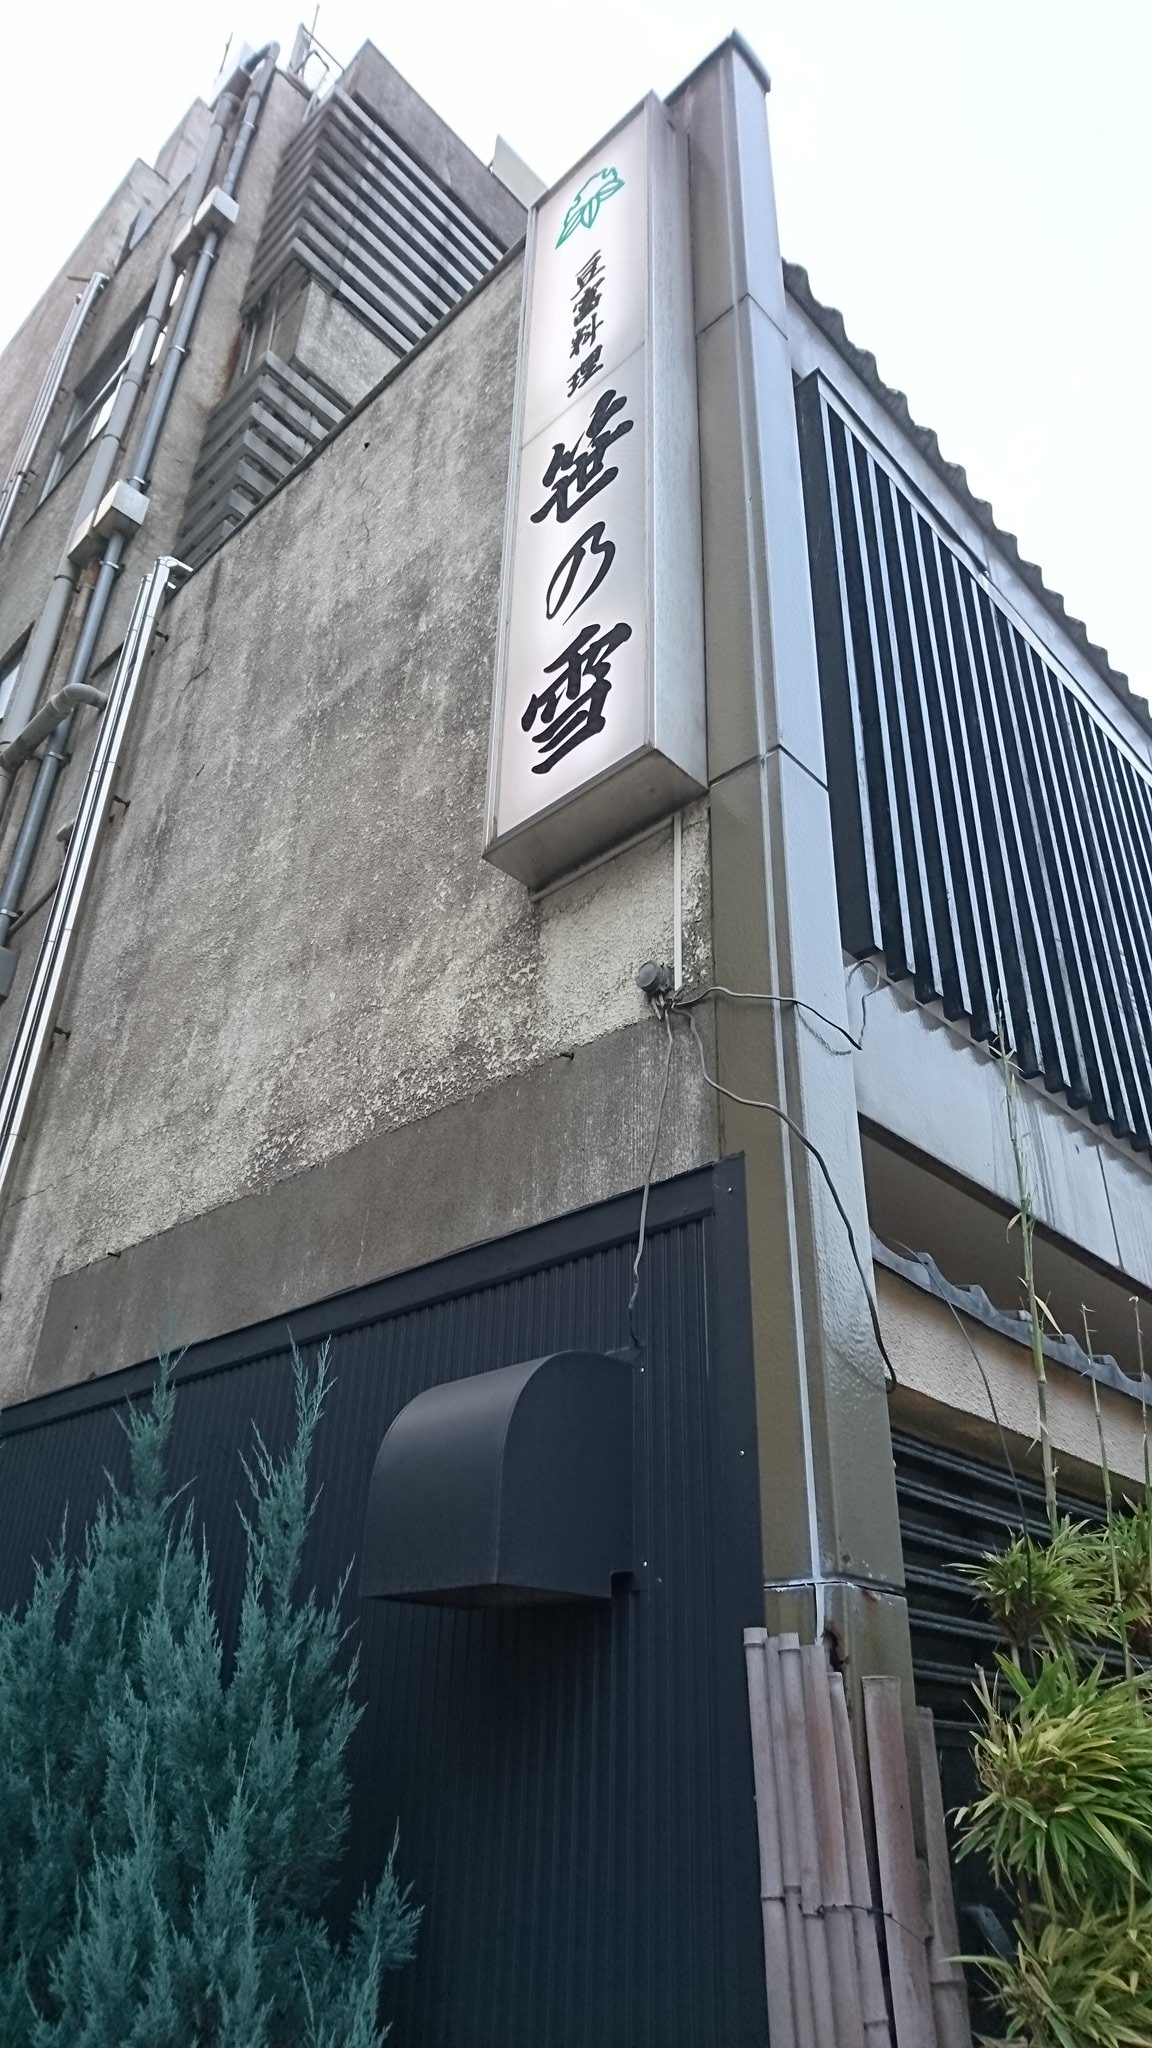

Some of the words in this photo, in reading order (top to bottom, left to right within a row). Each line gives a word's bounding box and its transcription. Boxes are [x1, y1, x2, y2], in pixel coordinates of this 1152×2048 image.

[567, 249, 606, 398] 豆富料理
[521, 389, 634, 774] 笹乃雪
